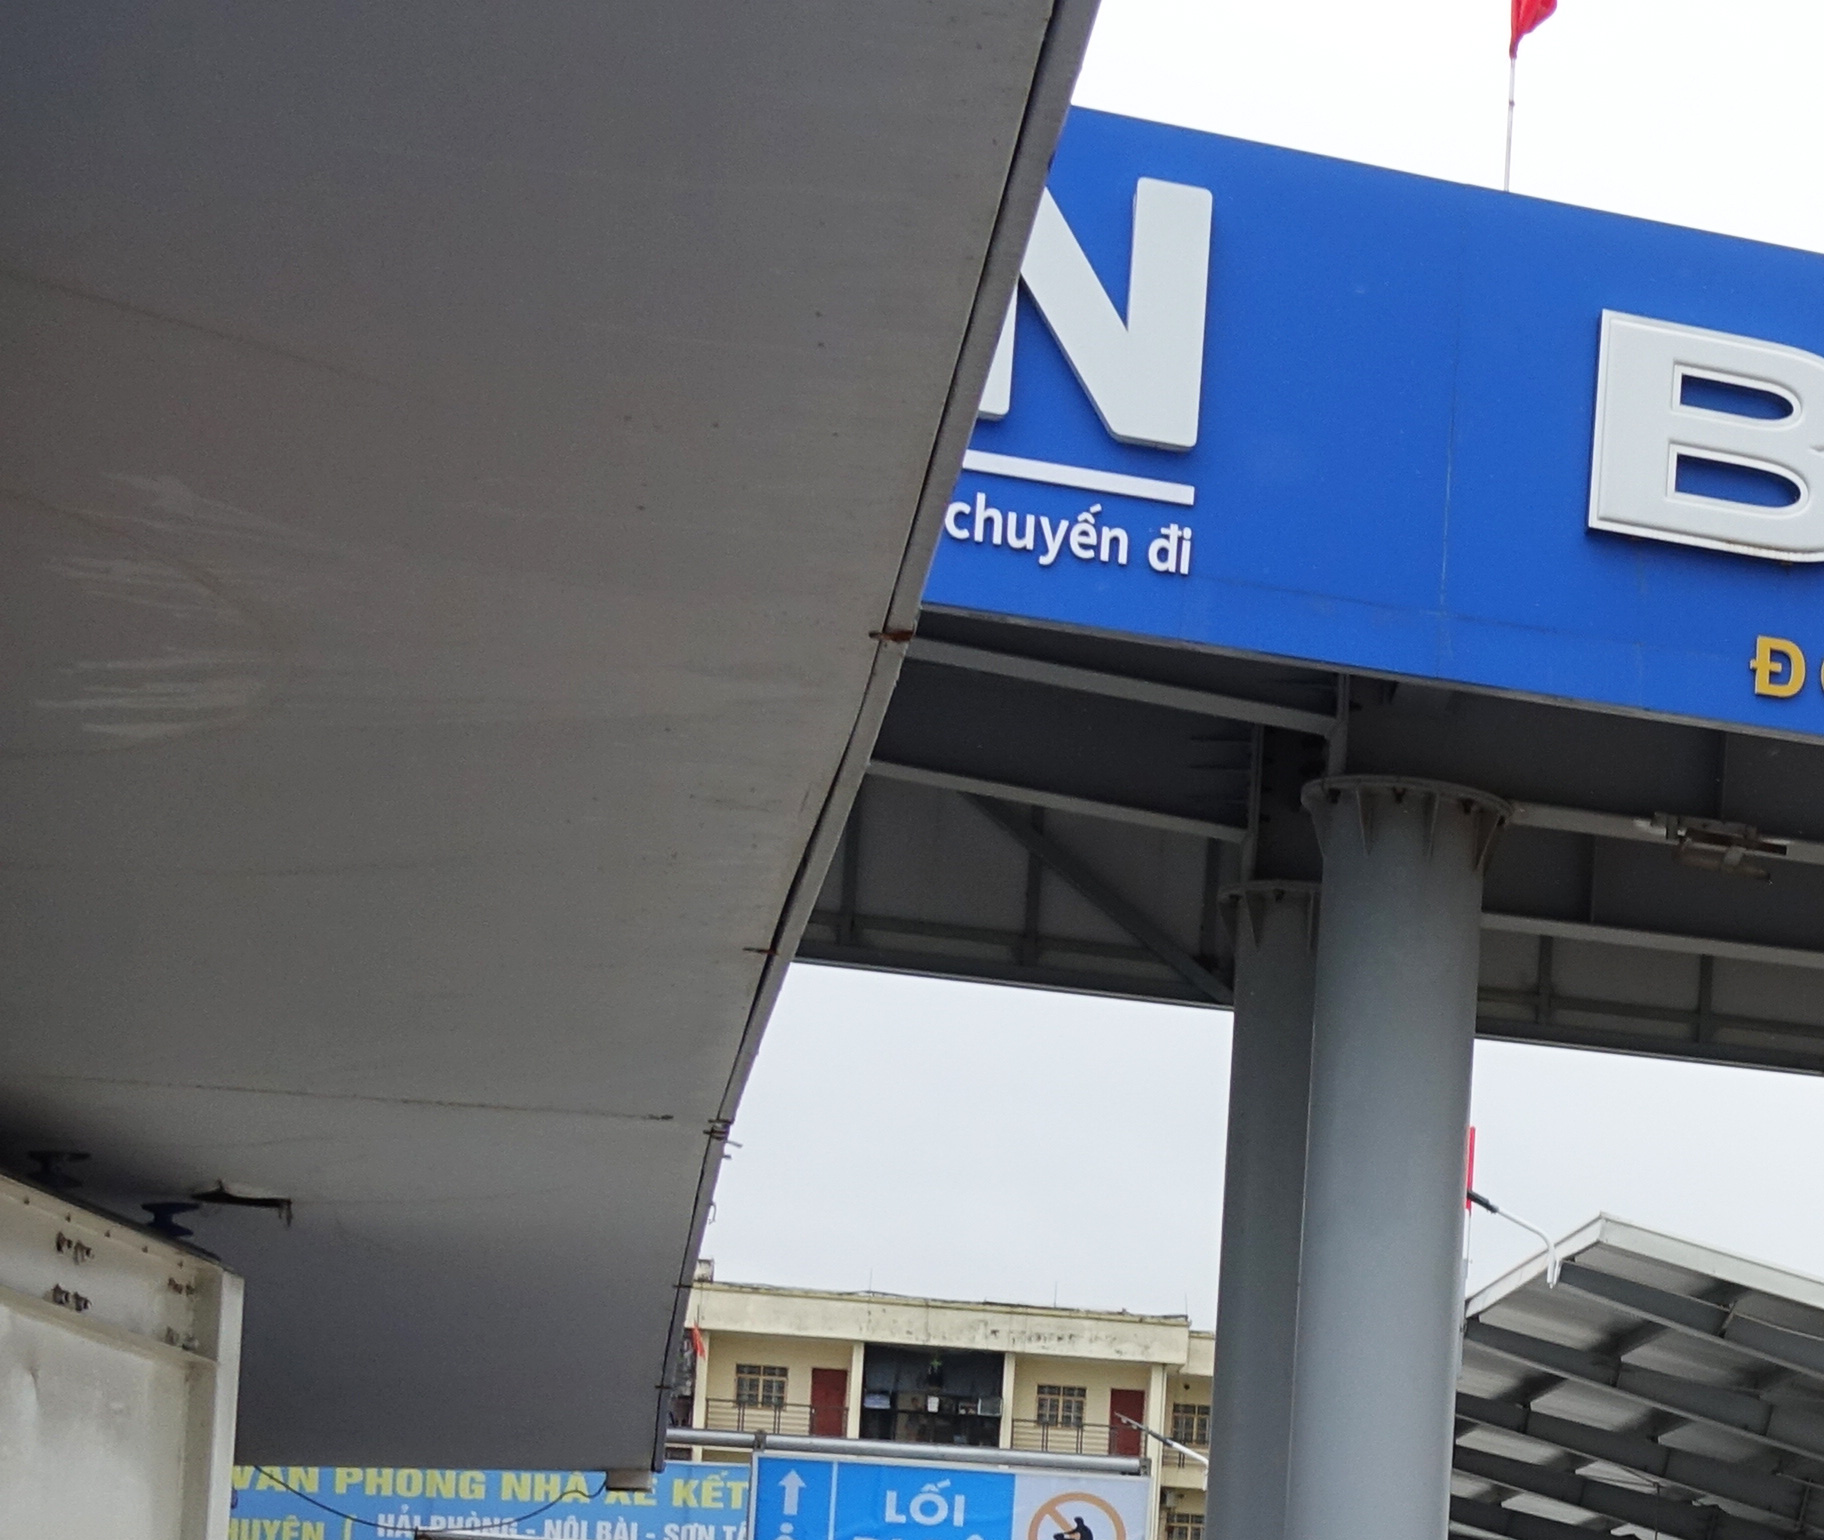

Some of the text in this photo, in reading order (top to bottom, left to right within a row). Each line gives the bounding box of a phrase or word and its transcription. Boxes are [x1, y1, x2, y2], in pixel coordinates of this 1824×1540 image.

[944, 491, 1192, 576] chuyến đi
[885, 1479, 965, 1527] LỐI
